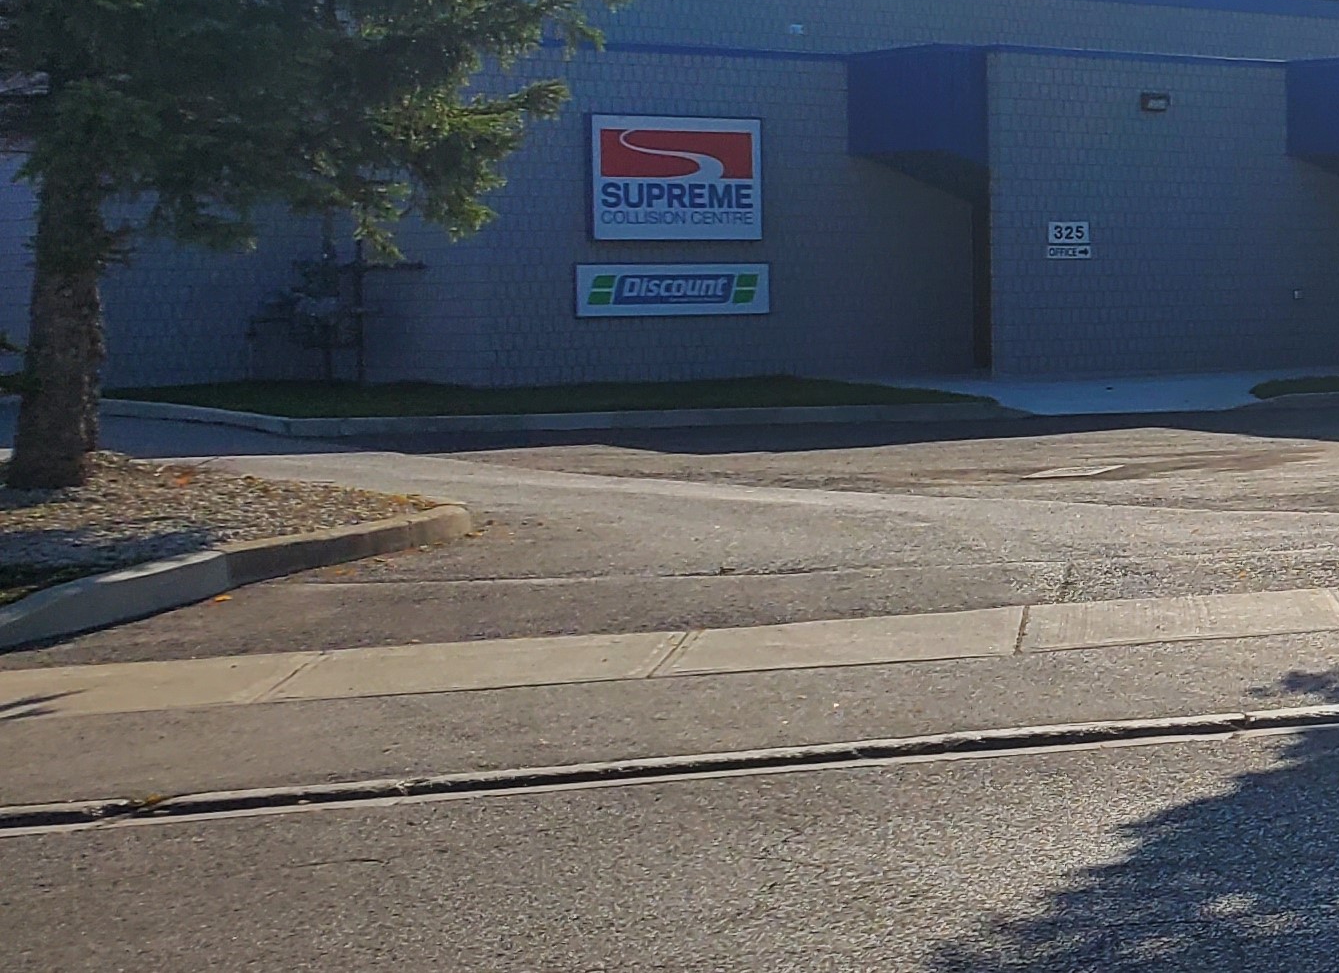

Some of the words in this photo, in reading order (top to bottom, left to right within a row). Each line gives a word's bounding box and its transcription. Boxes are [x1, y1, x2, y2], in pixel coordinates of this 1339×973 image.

[601, 182, 754, 209] SUPREME
[601, 210, 686, 225] COLLISION
[690, 211, 754, 225] CENTRE
[1054, 225, 1085, 240] 325
[622, 276, 728, 297] Discount
